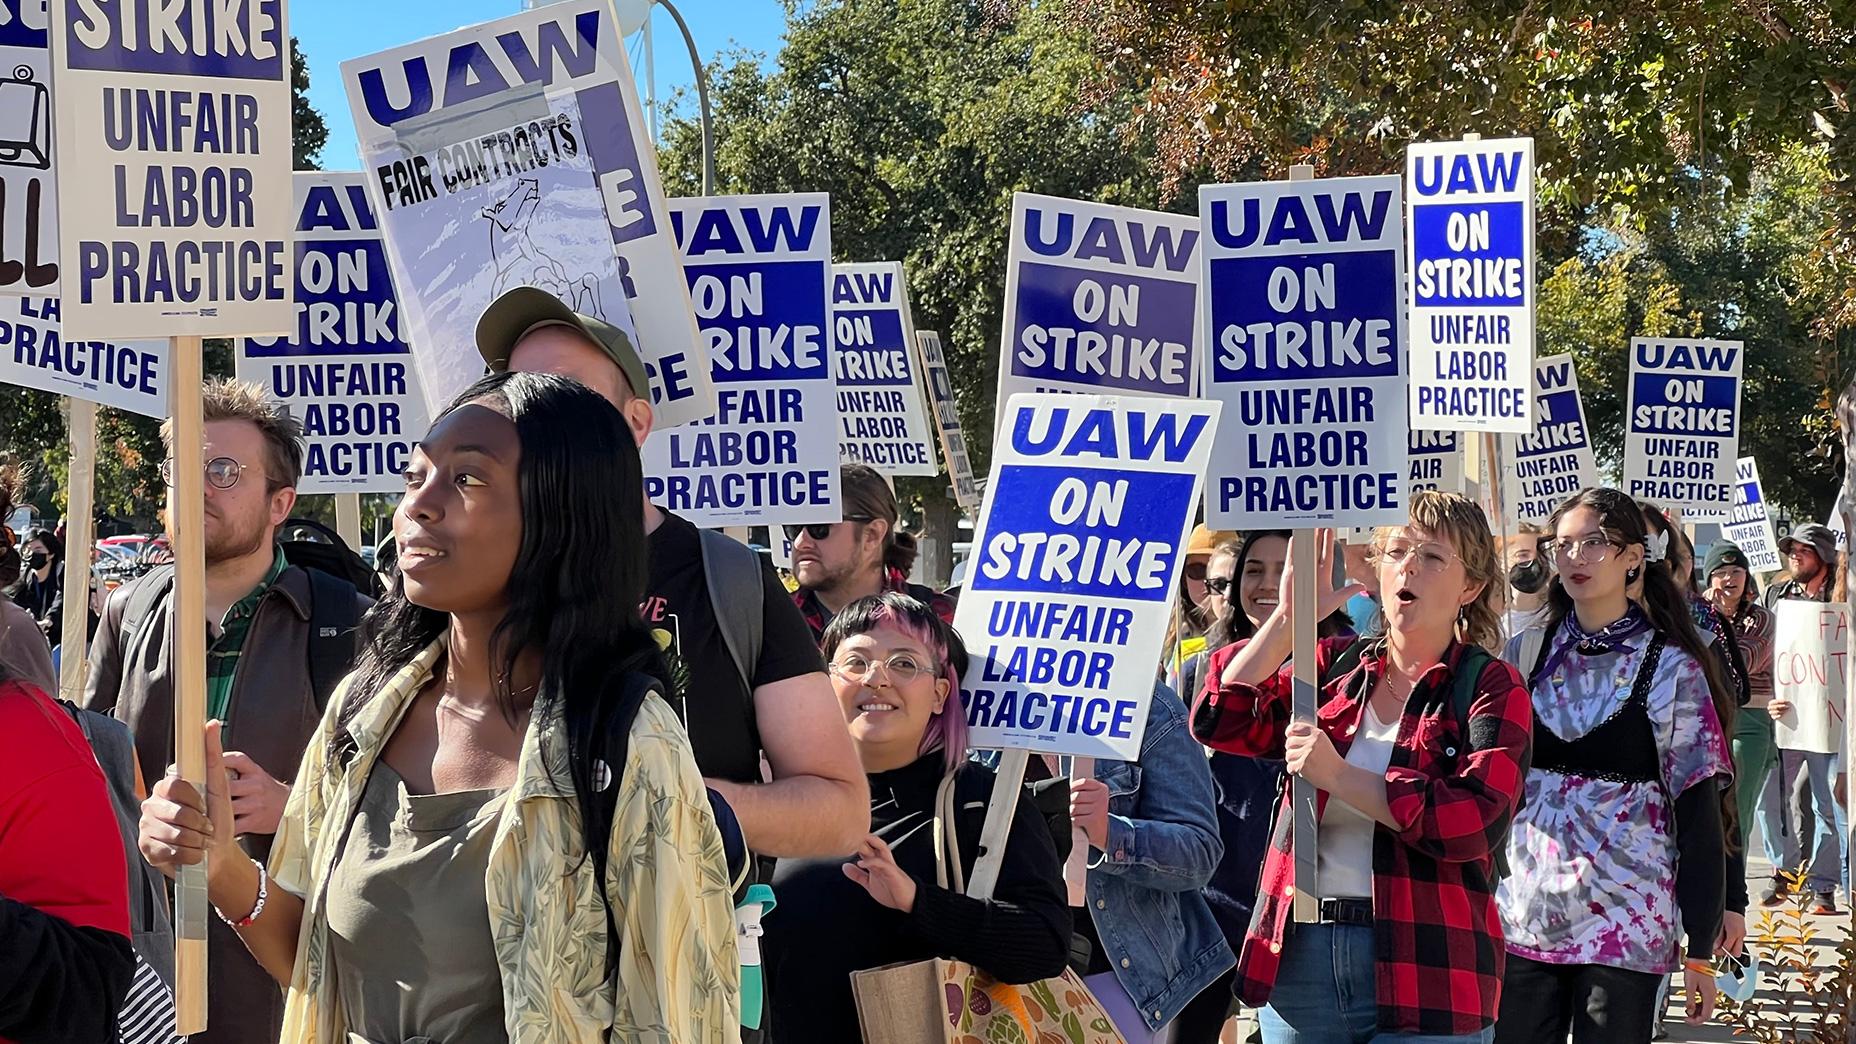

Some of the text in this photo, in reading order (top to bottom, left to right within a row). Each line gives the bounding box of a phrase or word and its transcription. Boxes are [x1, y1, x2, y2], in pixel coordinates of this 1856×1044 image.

[73, 0, 277, 60] STRIKE
[358, 10, 600, 127] UAW
[103, 87, 260, 155] UNFAIR
[377, 155, 438, 211] FAIR
[437, 113, 578, 194] CONTRACTS
[1414, 151, 1524, 197] UAW
[114, 165, 255, 228] LABOR
[1211, 190, 1393, 249] UAW
[1446, 210, 1489, 252] ON
[1024, 208, 1200, 272] UAW
[79, 240, 285, 304] PRACTICE
[300, 249, 368, 294] ON
[832, 272, 893, 304] AW
[1267, 263, 1335, 313] ON
[1416, 256, 1522, 299] STRIKE
[692, 271, 763, 319] ON
[1073, 279, 1140, 327] ON
[700, 322, 821, 371] RIKE
[836, 315, 874, 346] ON
[1219, 318, 1391, 370] STRIKE
[1430, 314, 1511, 345] UNFAIR
[836, 350, 908, 380] TRIKE
[1018, 324, 1186, 384] STRIKE
[1435, 350, 1507, 381] LABOR
[1636, 343, 1738, 372] UAW
[272, 362, 406, 398] UNFAIR
[1664, 378, 1704, 404] ON
[303, 402, 401, 436] ABOR
[690, 388, 803, 427] FAIR
[837, 391, 906, 412] UNFAIR
[1240, 386, 1374, 427] UNFAIR
[1418, 386, 1525, 418] PRACTICE
[1634, 404, 1732, 432] STRIKE
[842, 417, 908, 438] LABOR
[1011, 407, 1211, 463] UAW
[304, 441, 417, 476] ACTIC
[670, 429, 798, 469] LABOR
[1248, 430, 1368, 469] LABOR
[1516, 454, 1580, 478] UNFAIR
[1644, 438, 1719, 459] UNFAIR
[1409, 458, 1442, 480] AIR
[1522, 474, 1580, 498] LABOR
[1647, 459, 1714, 480] LABOR
[1049, 477, 1129, 527] ON
[1219, 473, 1398, 513] PRACTICE
[1630, 479, 1730, 502] PRACTICE
[1730, 525, 1765, 541] UNFAIR
[1742, 540, 1767, 553] ABOR
[981, 531, 1171, 589] STRIKE
[1750, 552, 1777, 567] CTICE
[987, 601, 1134, 646] UNFAIR
[981, 645, 1115, 690] LABOR
